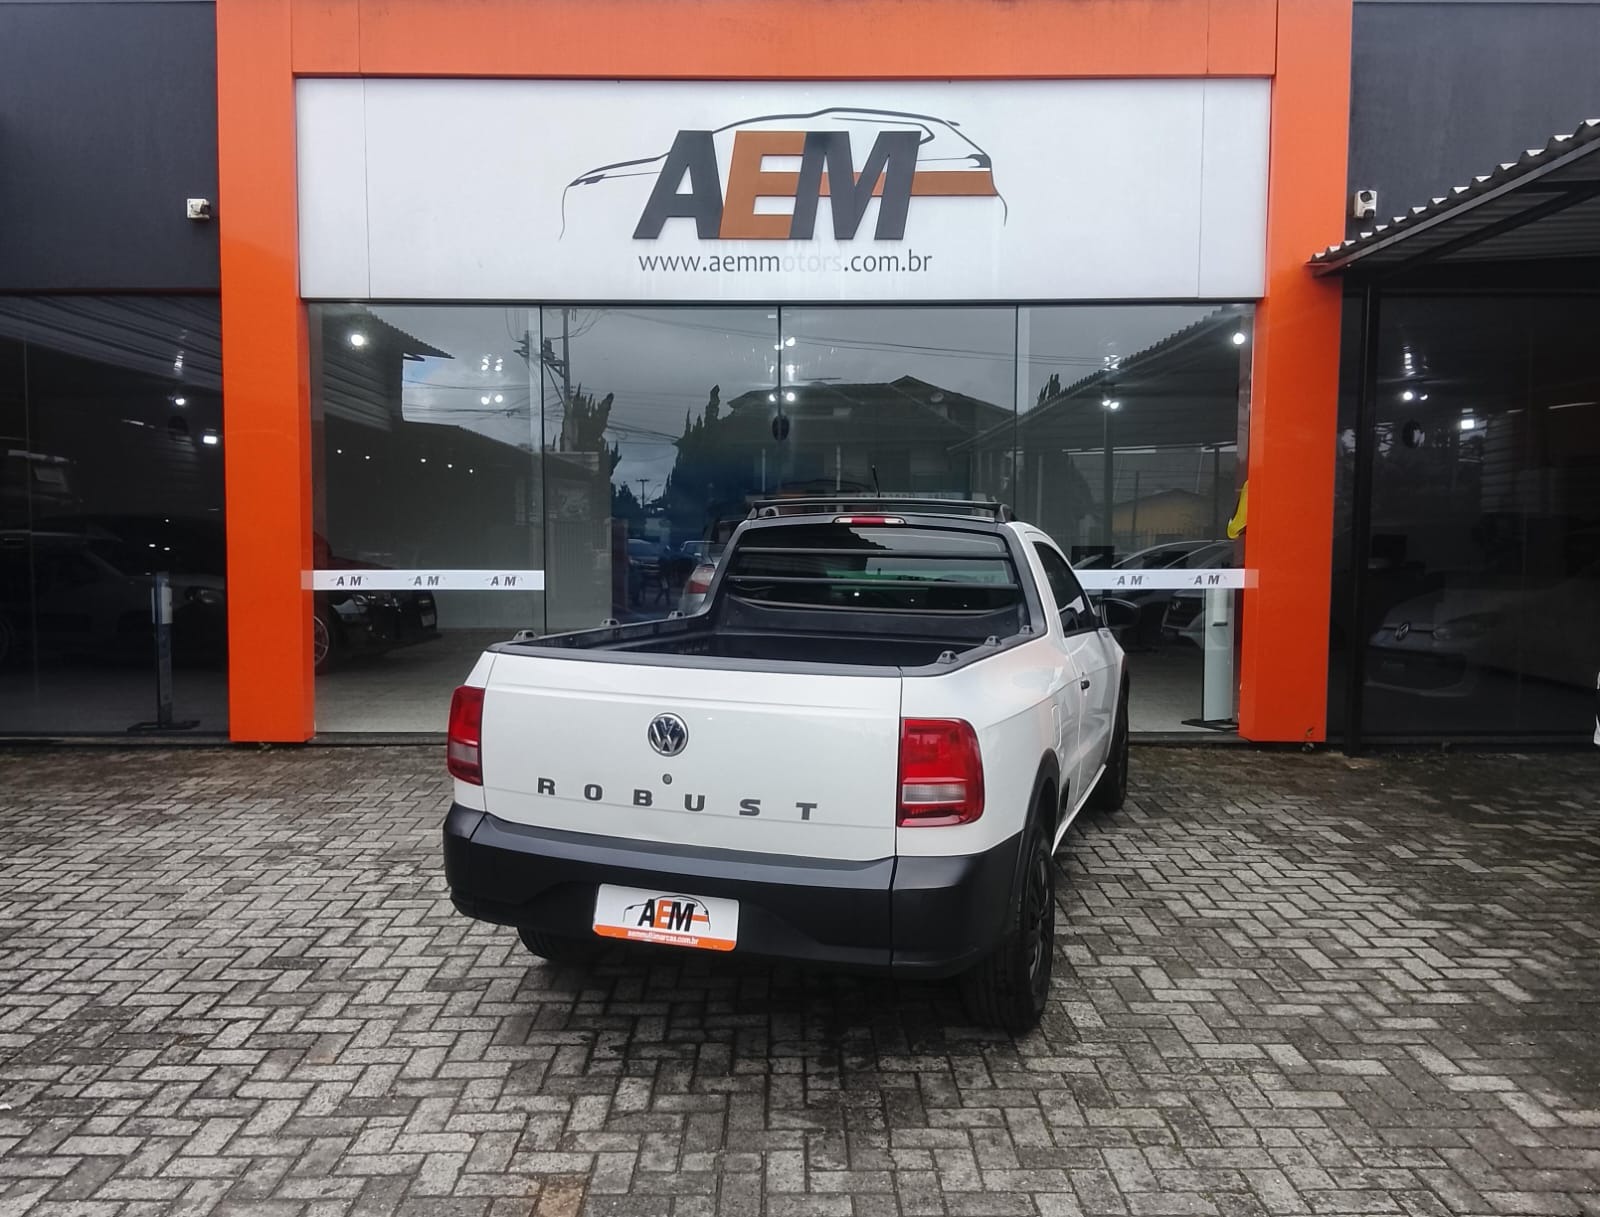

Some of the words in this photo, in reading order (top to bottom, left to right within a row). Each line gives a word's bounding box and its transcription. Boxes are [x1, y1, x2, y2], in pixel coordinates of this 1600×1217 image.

[632, 129, 922, 240] AEM
[638, 249, 932, 275] www.aemmotors.com.br
[537, 777, 818, 821] ROBUST
[637, 898, 696, 932] AEM
